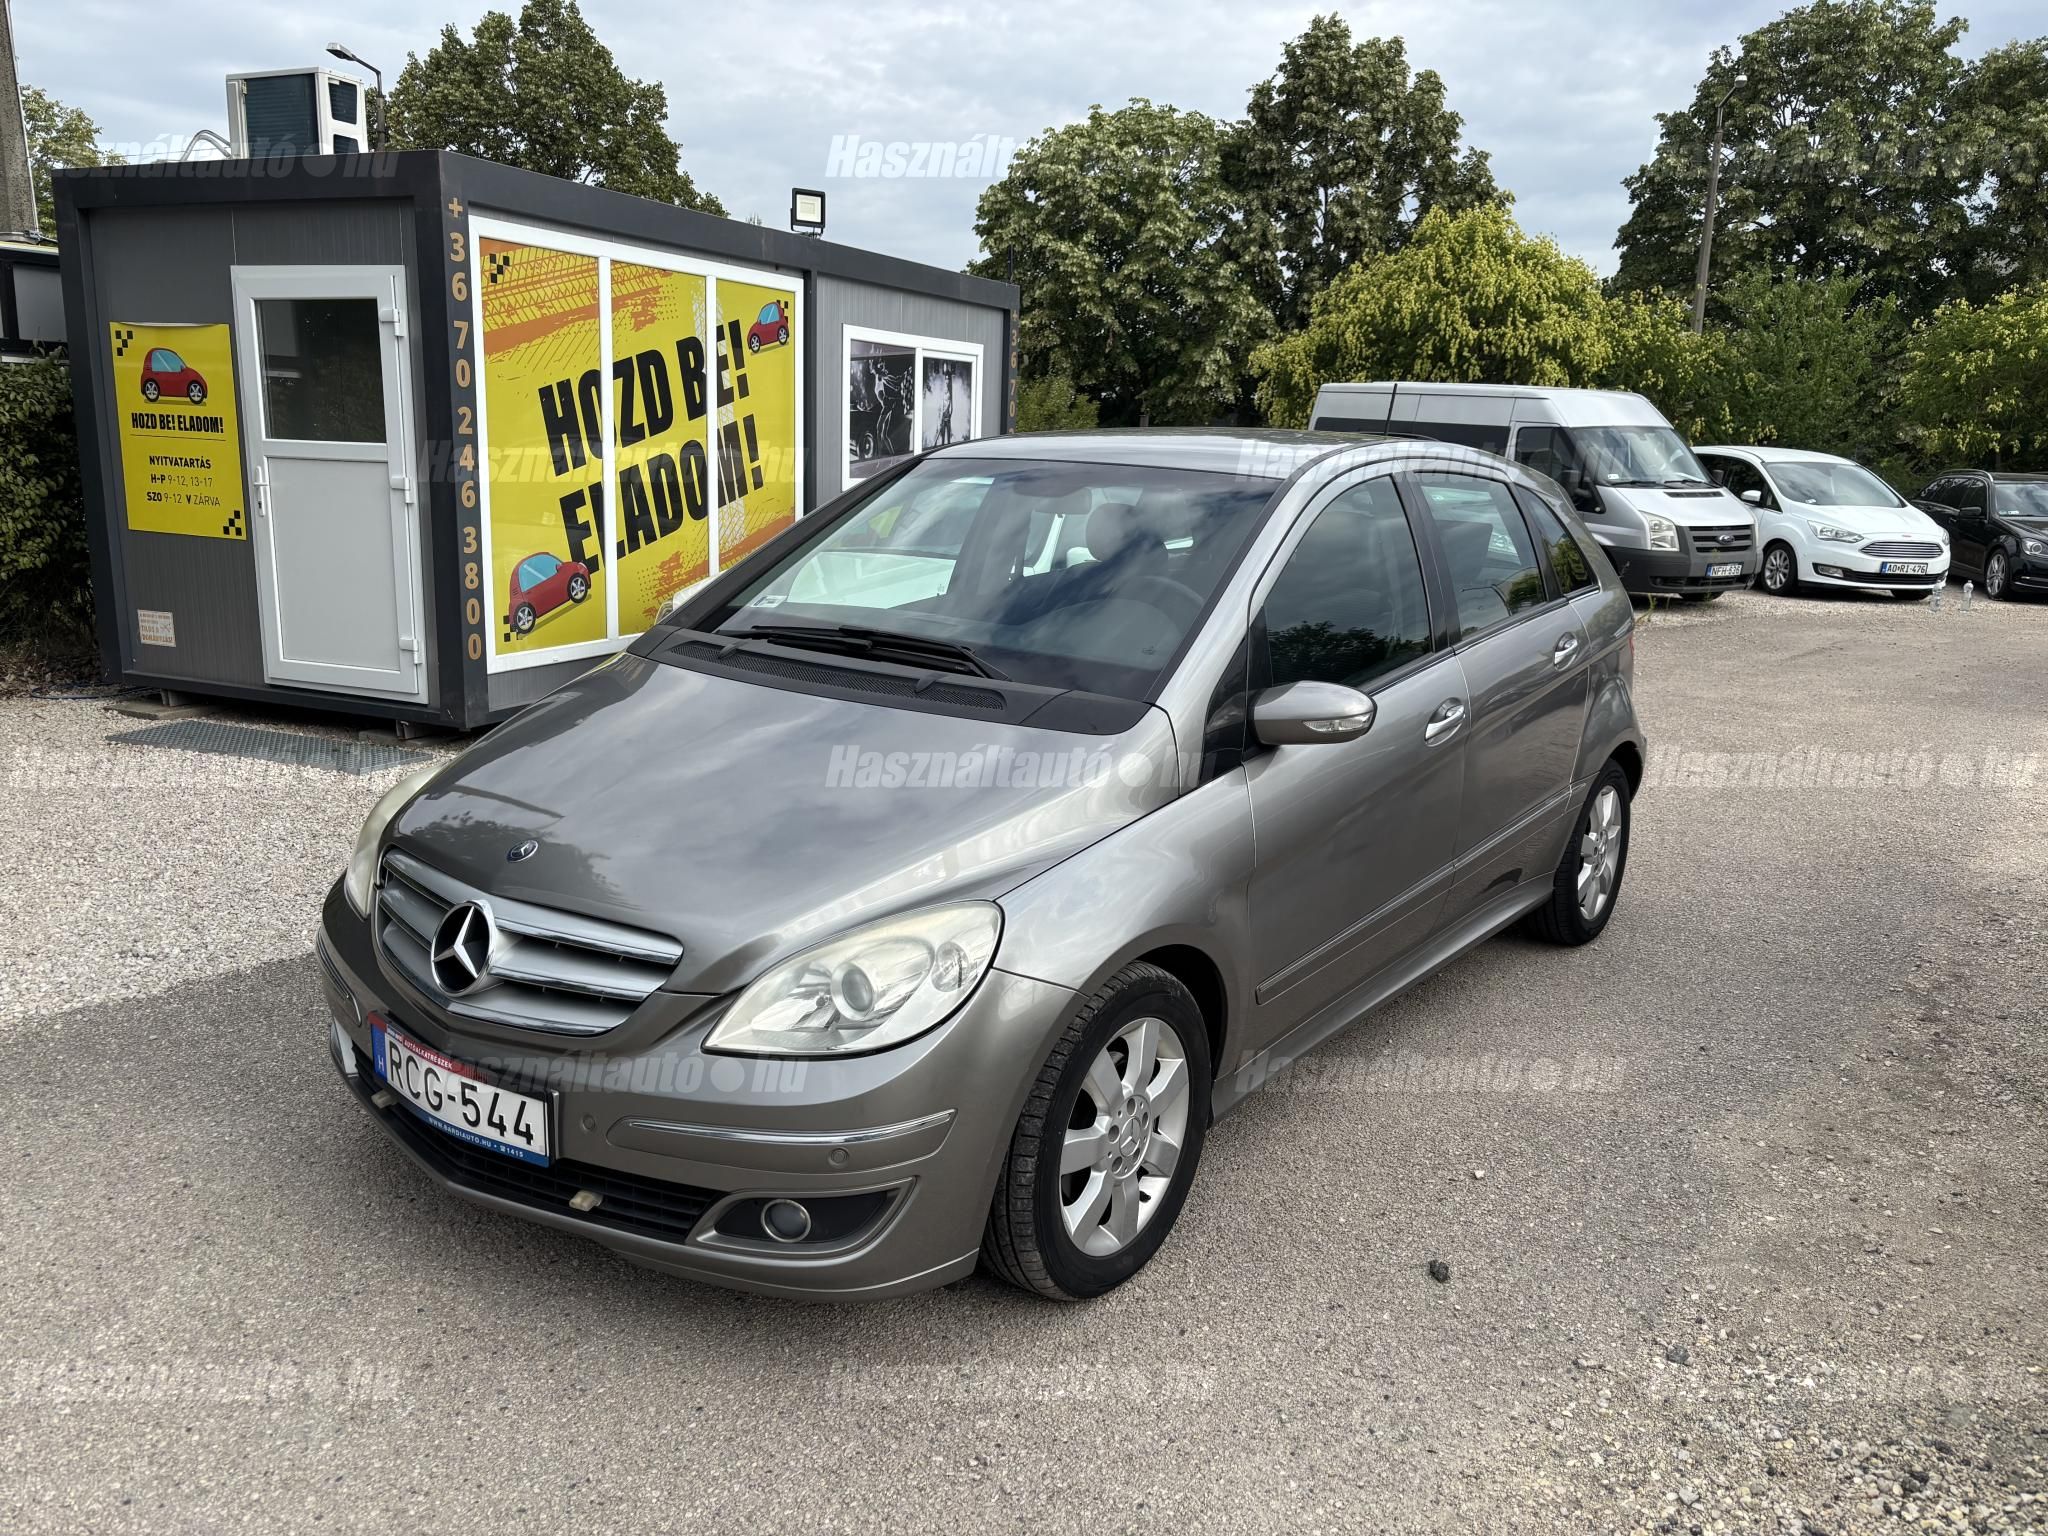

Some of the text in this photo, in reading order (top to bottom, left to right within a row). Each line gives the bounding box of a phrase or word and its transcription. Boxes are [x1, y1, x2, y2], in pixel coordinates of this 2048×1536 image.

[538, 319, 750, 477] HOZD BE!
[131, 412, 224, 434] HOZD BE! ELADOM!
[148, 455, 212, 470] NYITVATARTÁS
[150, 473, 166, 484] H-P
[190, 476, 213, 488] 13-17
[146, 491, 221, 507] SZO 9-12 V ZÁRVA
[559, 413, 764, 575] ELADOM!
[388, 1040, 534, 1146] RCG-544
